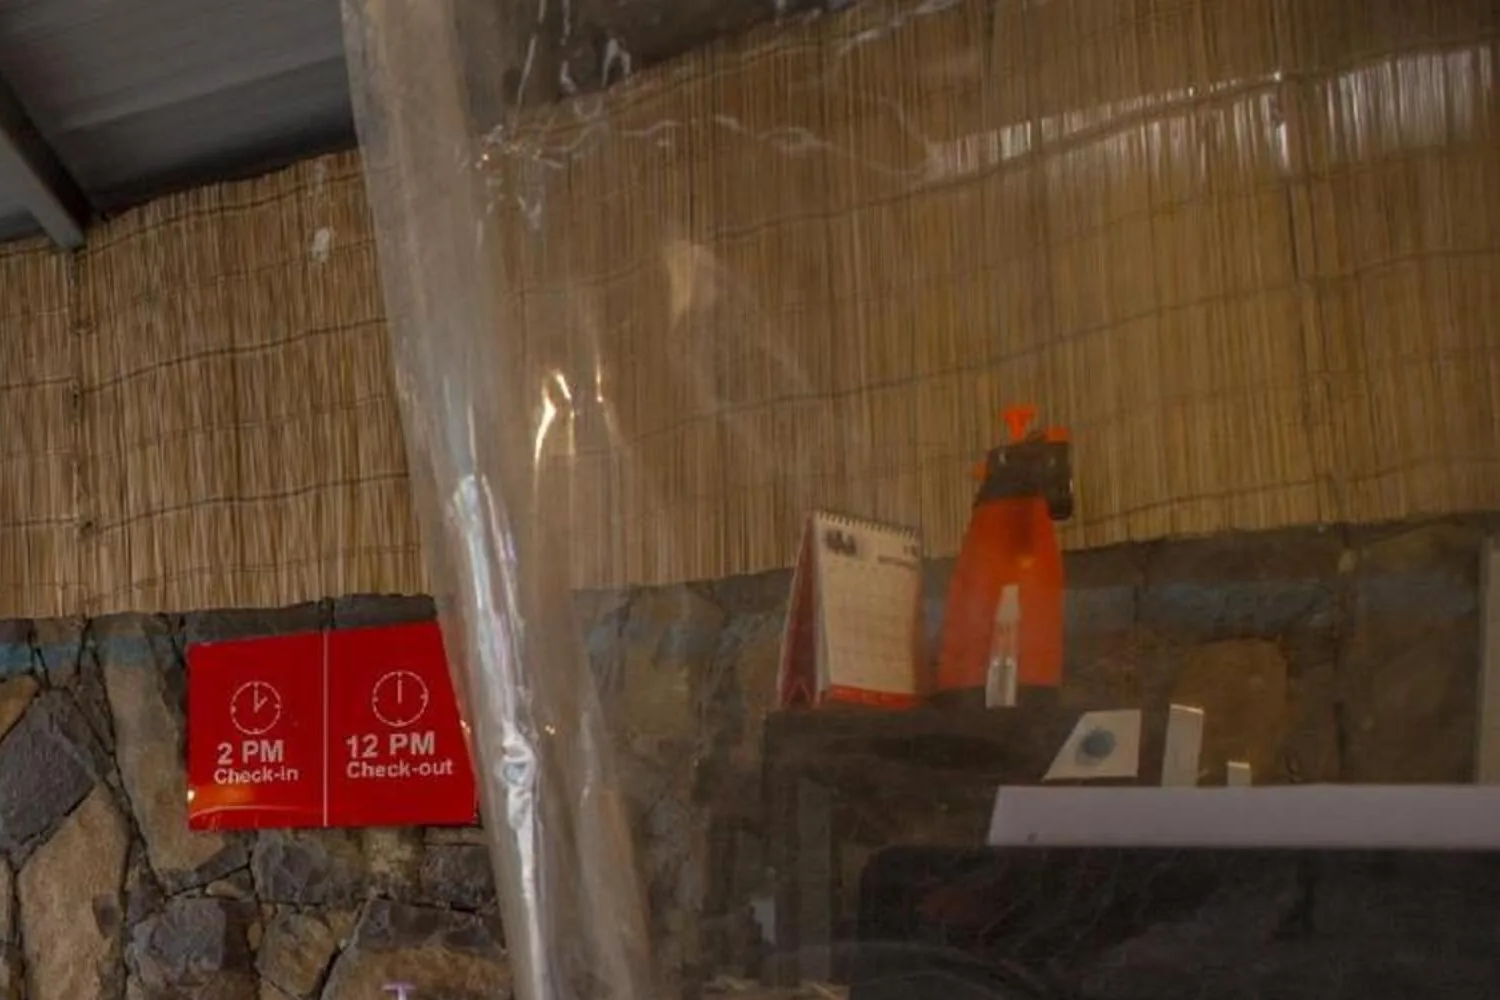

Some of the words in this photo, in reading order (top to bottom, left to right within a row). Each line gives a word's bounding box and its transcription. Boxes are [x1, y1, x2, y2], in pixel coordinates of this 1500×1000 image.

[217, 743, 233, 765] 2
[242, 740, 284, 763] PM
[347, 734, 379, 759] 12
[390, 731, 435, 755] PM
[214, 767, 298, 785] Check-in
[347, 760, 452, 778] Check-out
